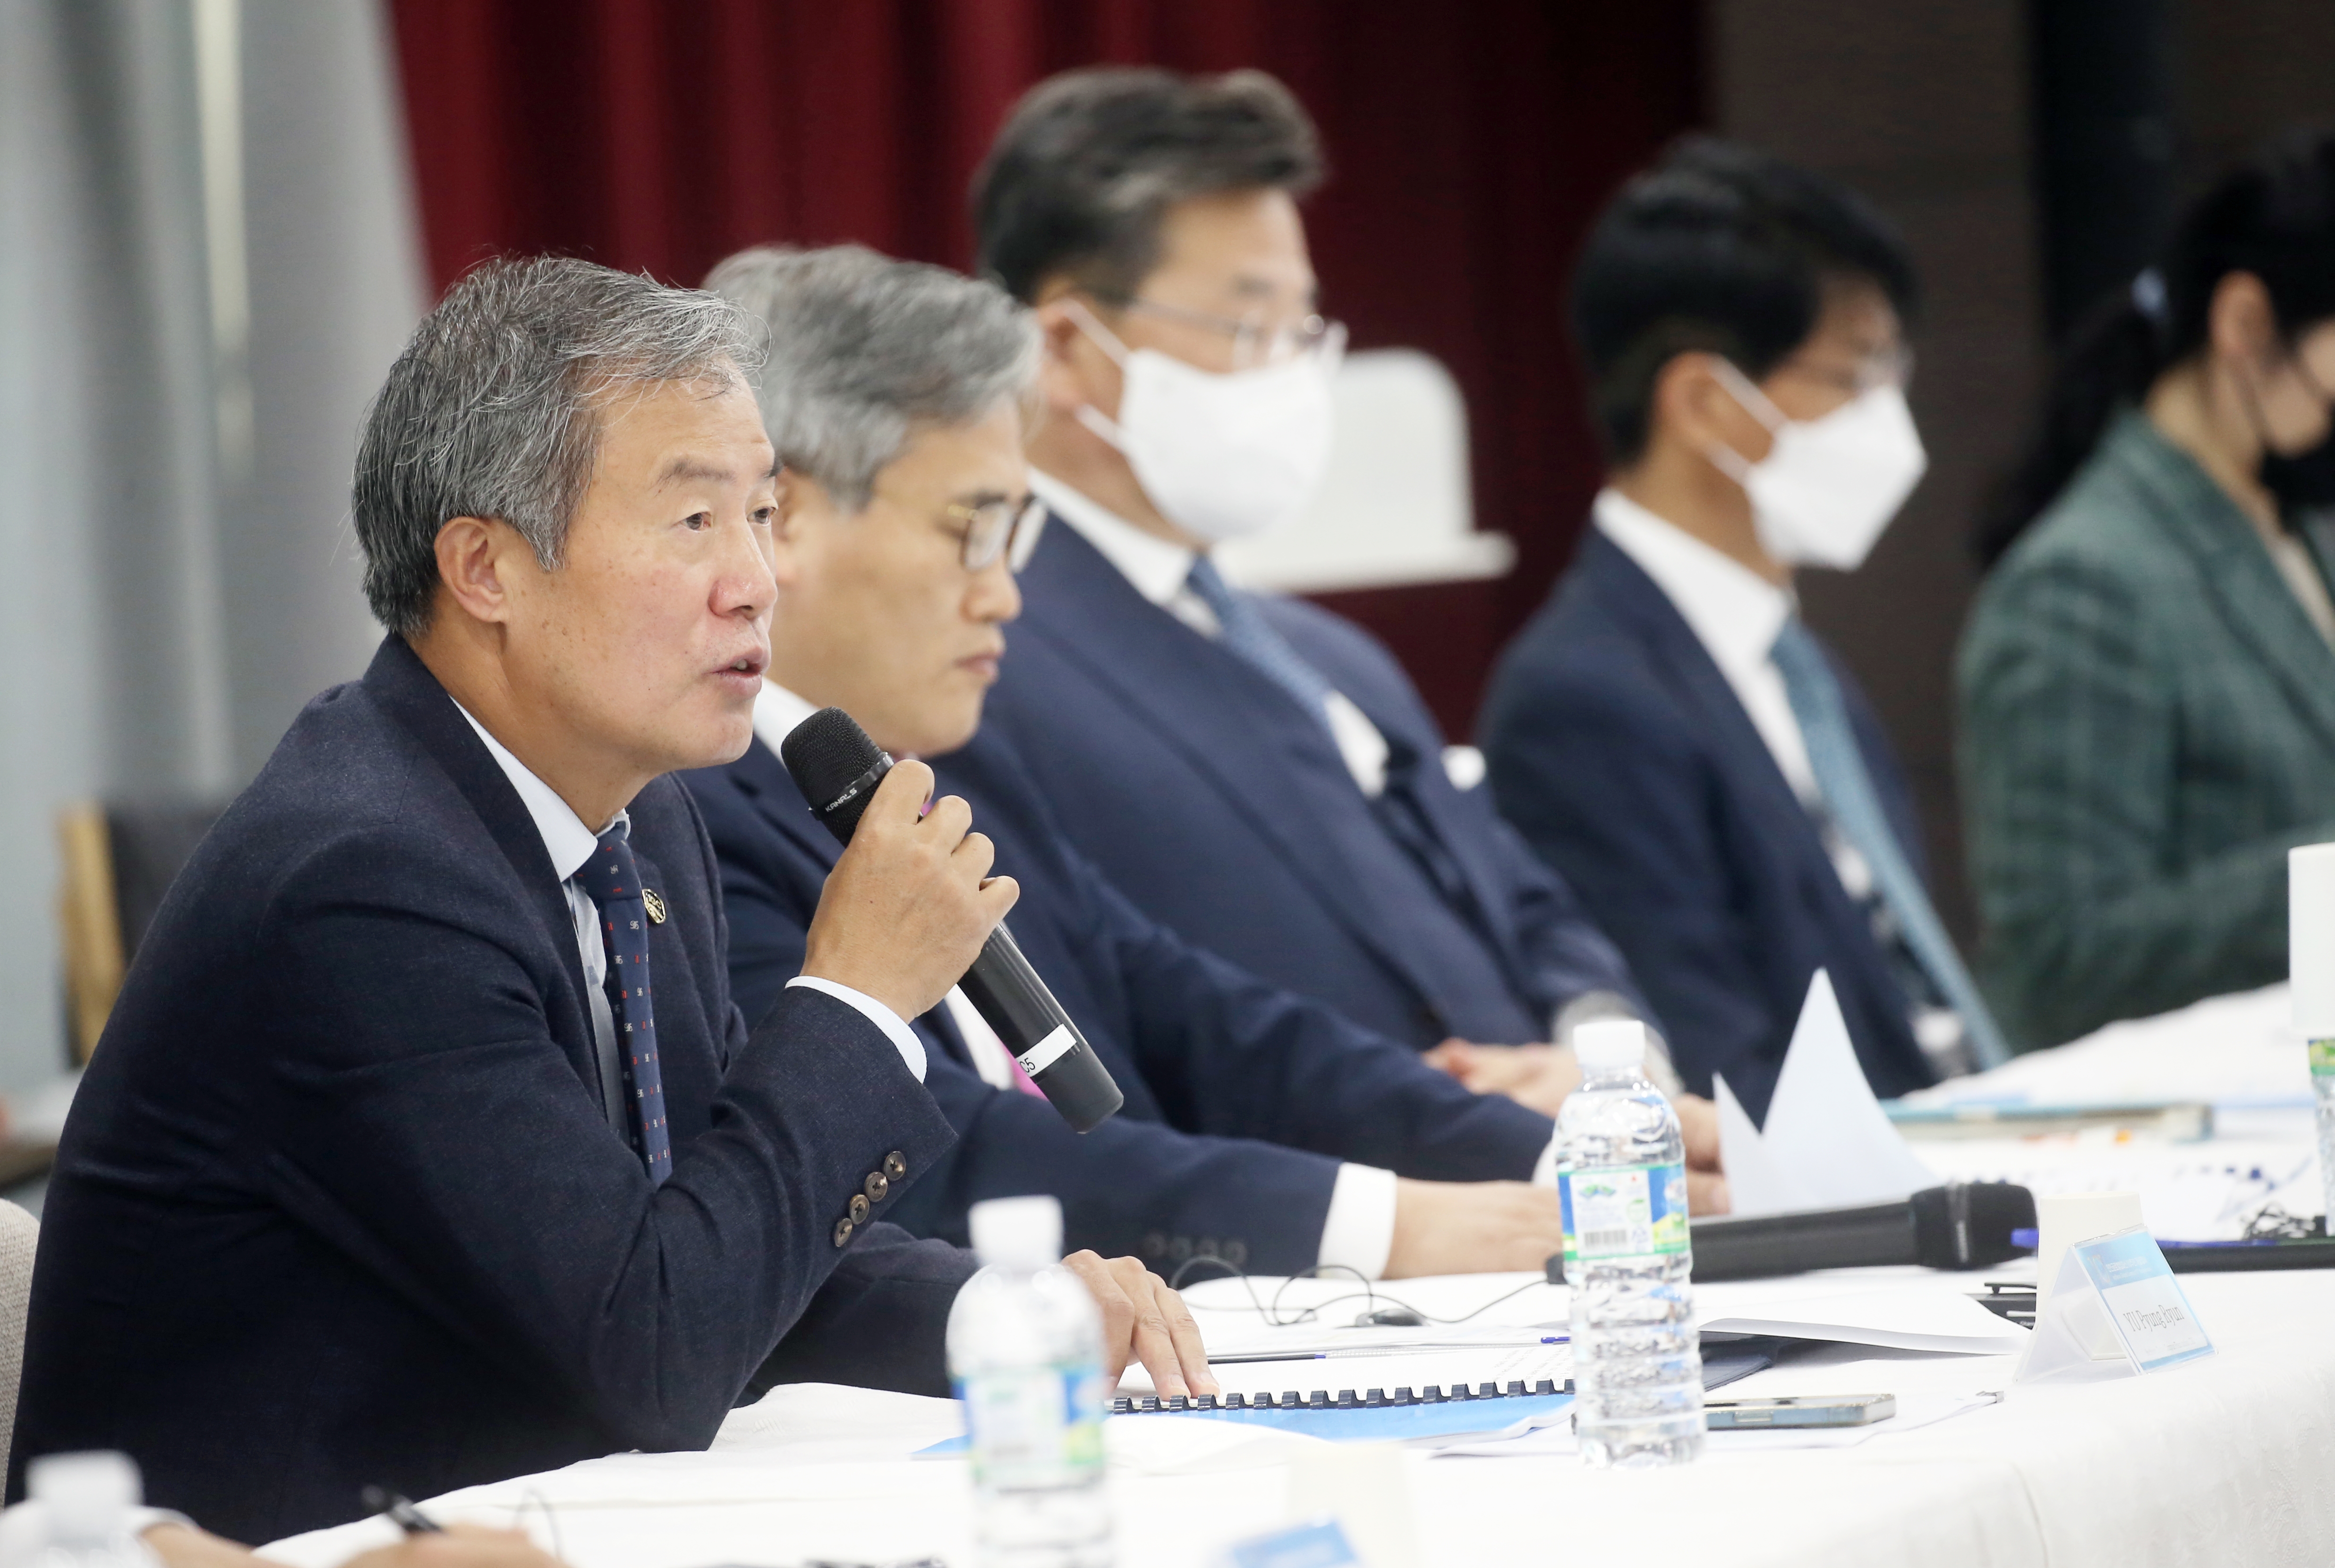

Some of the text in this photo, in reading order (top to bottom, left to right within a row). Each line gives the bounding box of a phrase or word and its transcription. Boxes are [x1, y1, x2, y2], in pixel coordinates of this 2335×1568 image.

[825, 787, 857, 812] KANALS
[2123, 1304, 2185, 1332] YU Pyung Ryun
